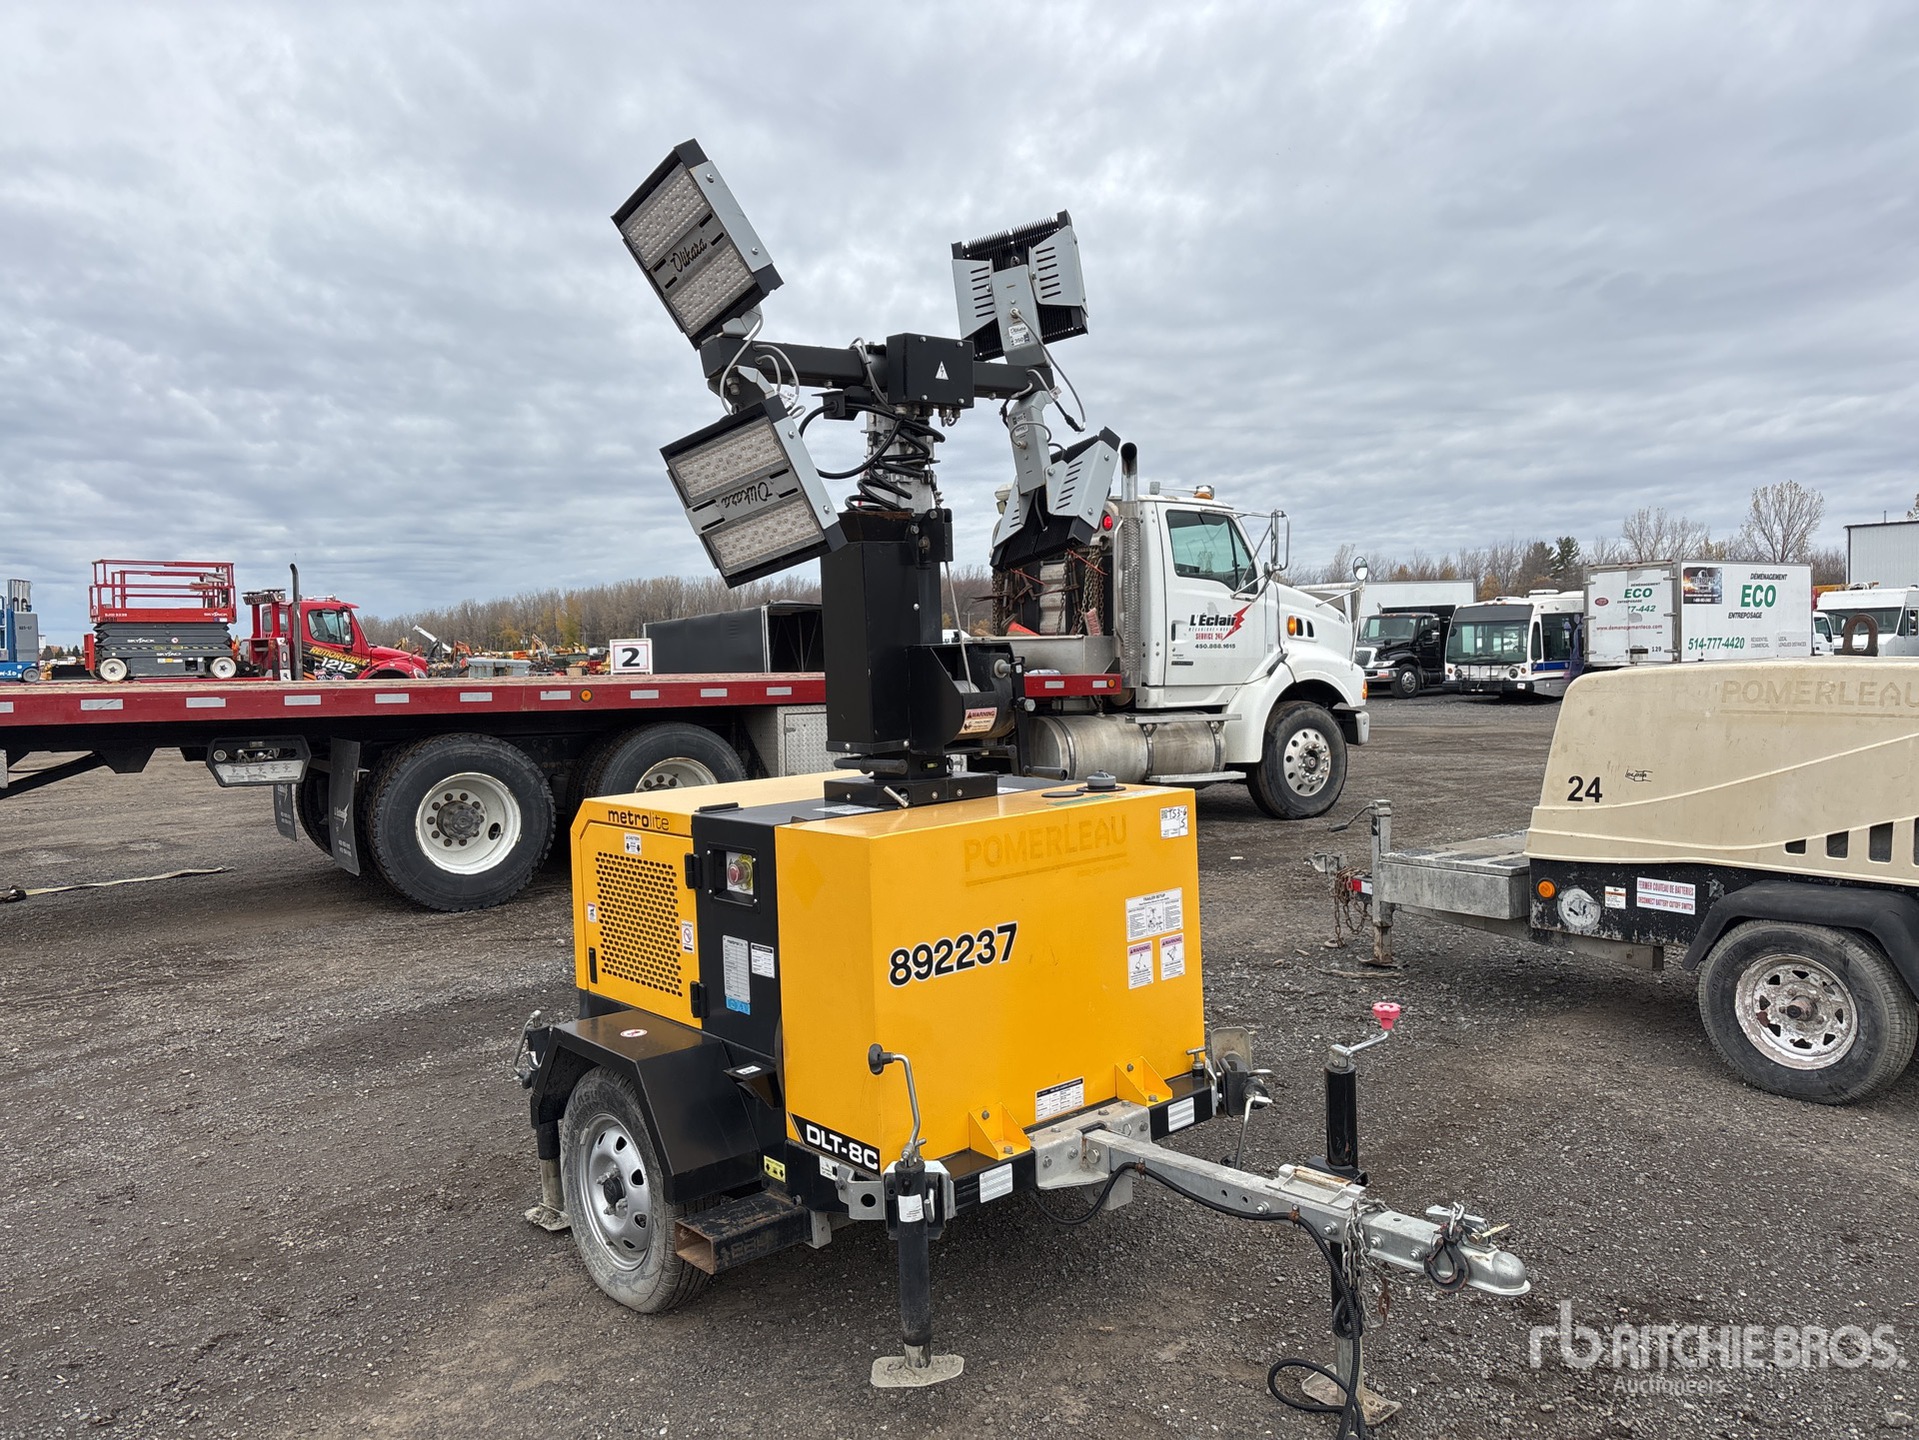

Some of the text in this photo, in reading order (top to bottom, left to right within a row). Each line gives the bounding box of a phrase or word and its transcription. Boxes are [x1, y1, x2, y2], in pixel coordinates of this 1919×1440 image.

[1624, 587, 1653, 599] ECO
[1741, 584, 1777, 608] ECO
[1189, 612, 1237, 627] L'Éclair
[1728, 611, 1763, 620] ENTREPOSAGE
[1195, 632, 1214, 640] SERVICE
[1688, 636, 1745, 651] 514-777-4420
[321, 656, 356, 673] 1212
[622, 647, 640, 667] 2
[971, 710, 995, 718] WARNING
[1567, 775, 1603, 803] 24
[608, 809, 670, 831] metrolite
[963, 814, 1128, 872] POMERLEAU
[1638, 880, 1653, 891] FERMER
[1669, 884, 1675, 893] DE
[1675, 885, 1694, 896] BATTERIES
[889, 921, 1018, 987] 892237
[806, 1124, 879, 1170] DLT-8C
